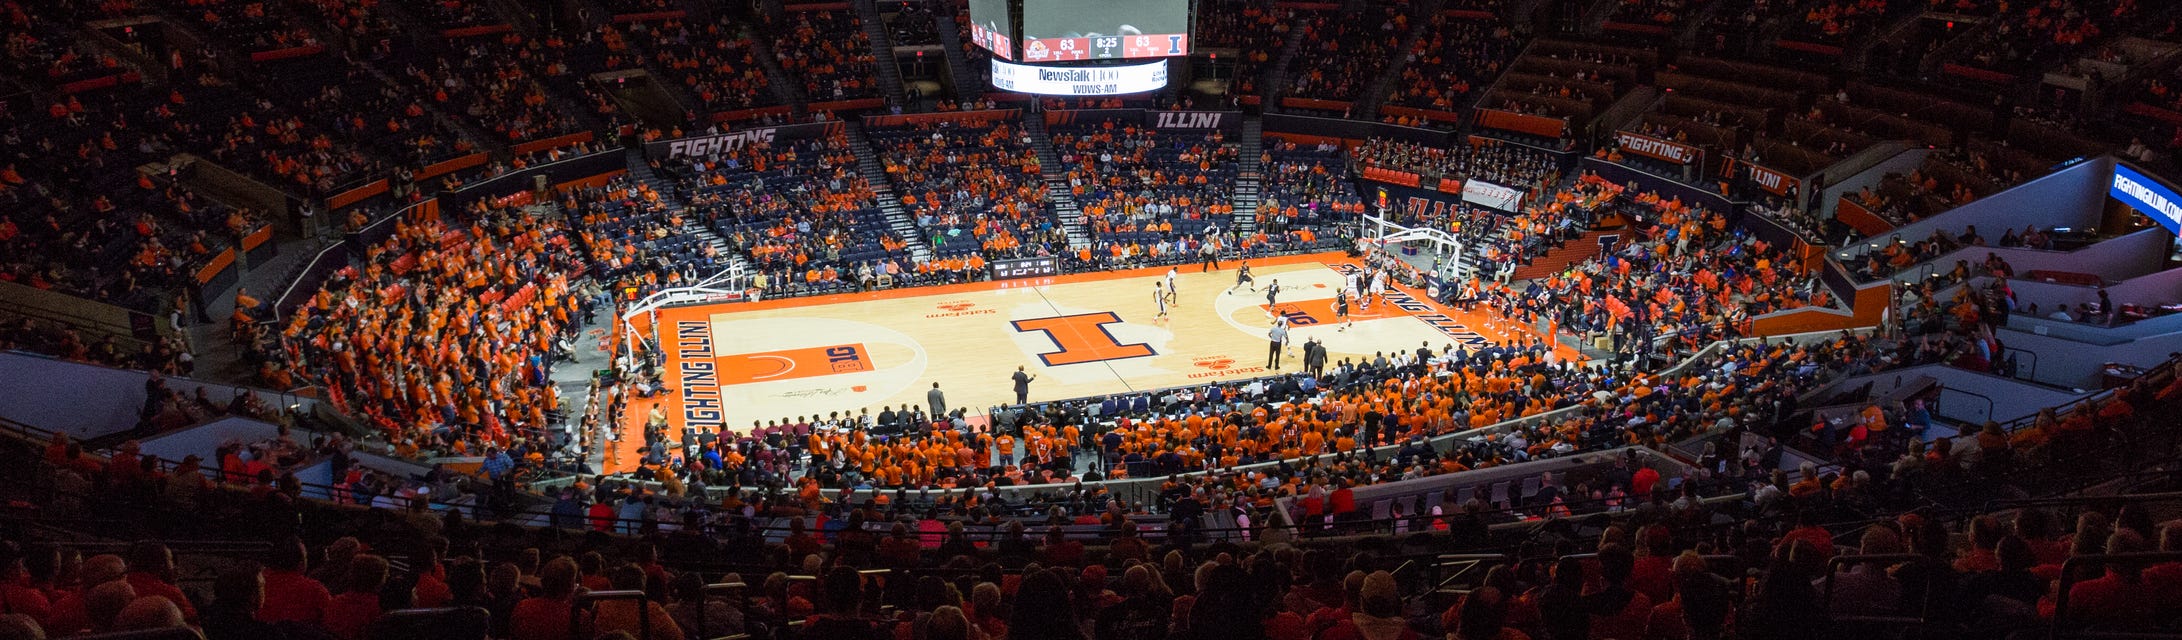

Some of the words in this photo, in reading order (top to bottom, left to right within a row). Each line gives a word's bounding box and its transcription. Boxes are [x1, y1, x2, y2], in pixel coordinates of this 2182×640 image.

[1060, 40, 1075, 51] 63
[1096, 37, 1117, 48] 8:25
[1135, 36, 1150, 48] 63
[1039, 68, 1090, 82] NewsTalk
[1073, 84, 1117, 94] WDWS-AM
[1157, 112, 1222, 128] ILLINI
[669, 128, 777, 160] FIGHTING
[1618, 134, 1684, 160] FIGHTING
[677, 321, 712, 359] ILLINI
